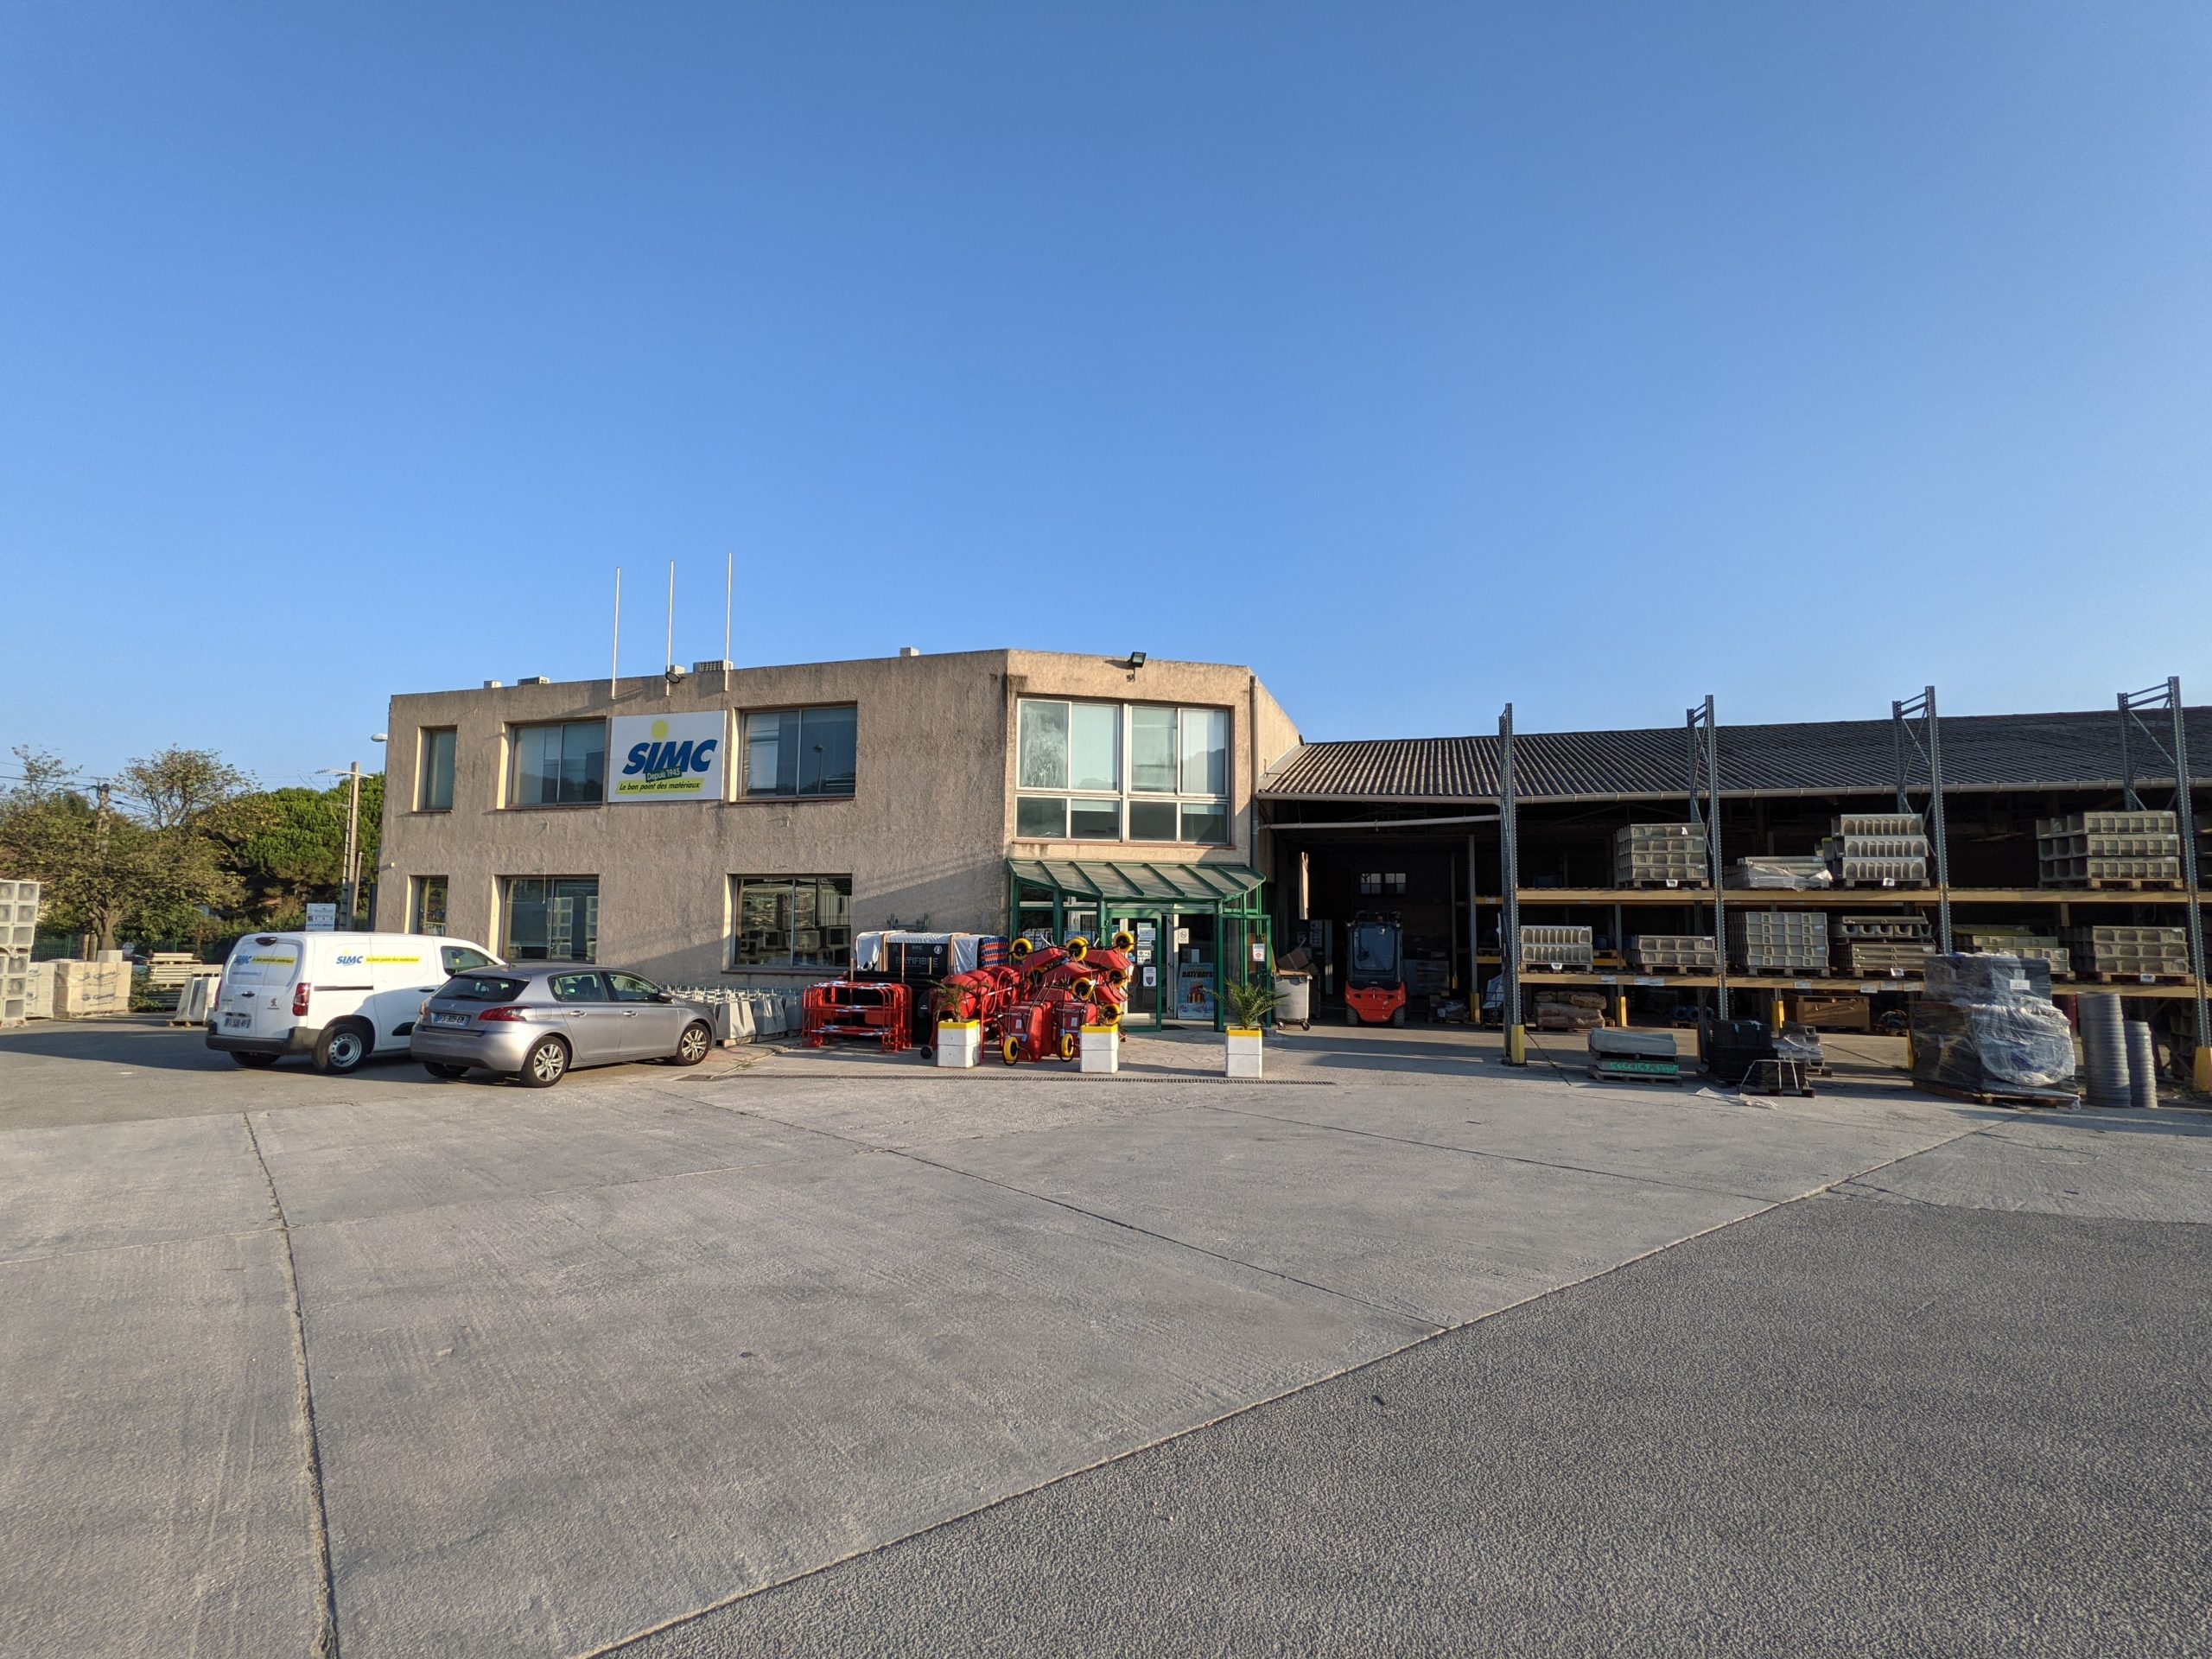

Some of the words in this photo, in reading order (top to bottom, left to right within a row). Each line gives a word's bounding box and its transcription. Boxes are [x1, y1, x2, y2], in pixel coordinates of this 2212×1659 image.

[622, 739, 718, 775] SIMC
[646, 771, 665, 782] Depuis
[666, 767, 681, 778] 1945
[627, 782, 639, 791] bon
[639, 781, 656, 792] point
[657, 781, 667, 790] des
[668, 780, 701, 790] matériaux
[336, 956, 363, 964] SIMC
